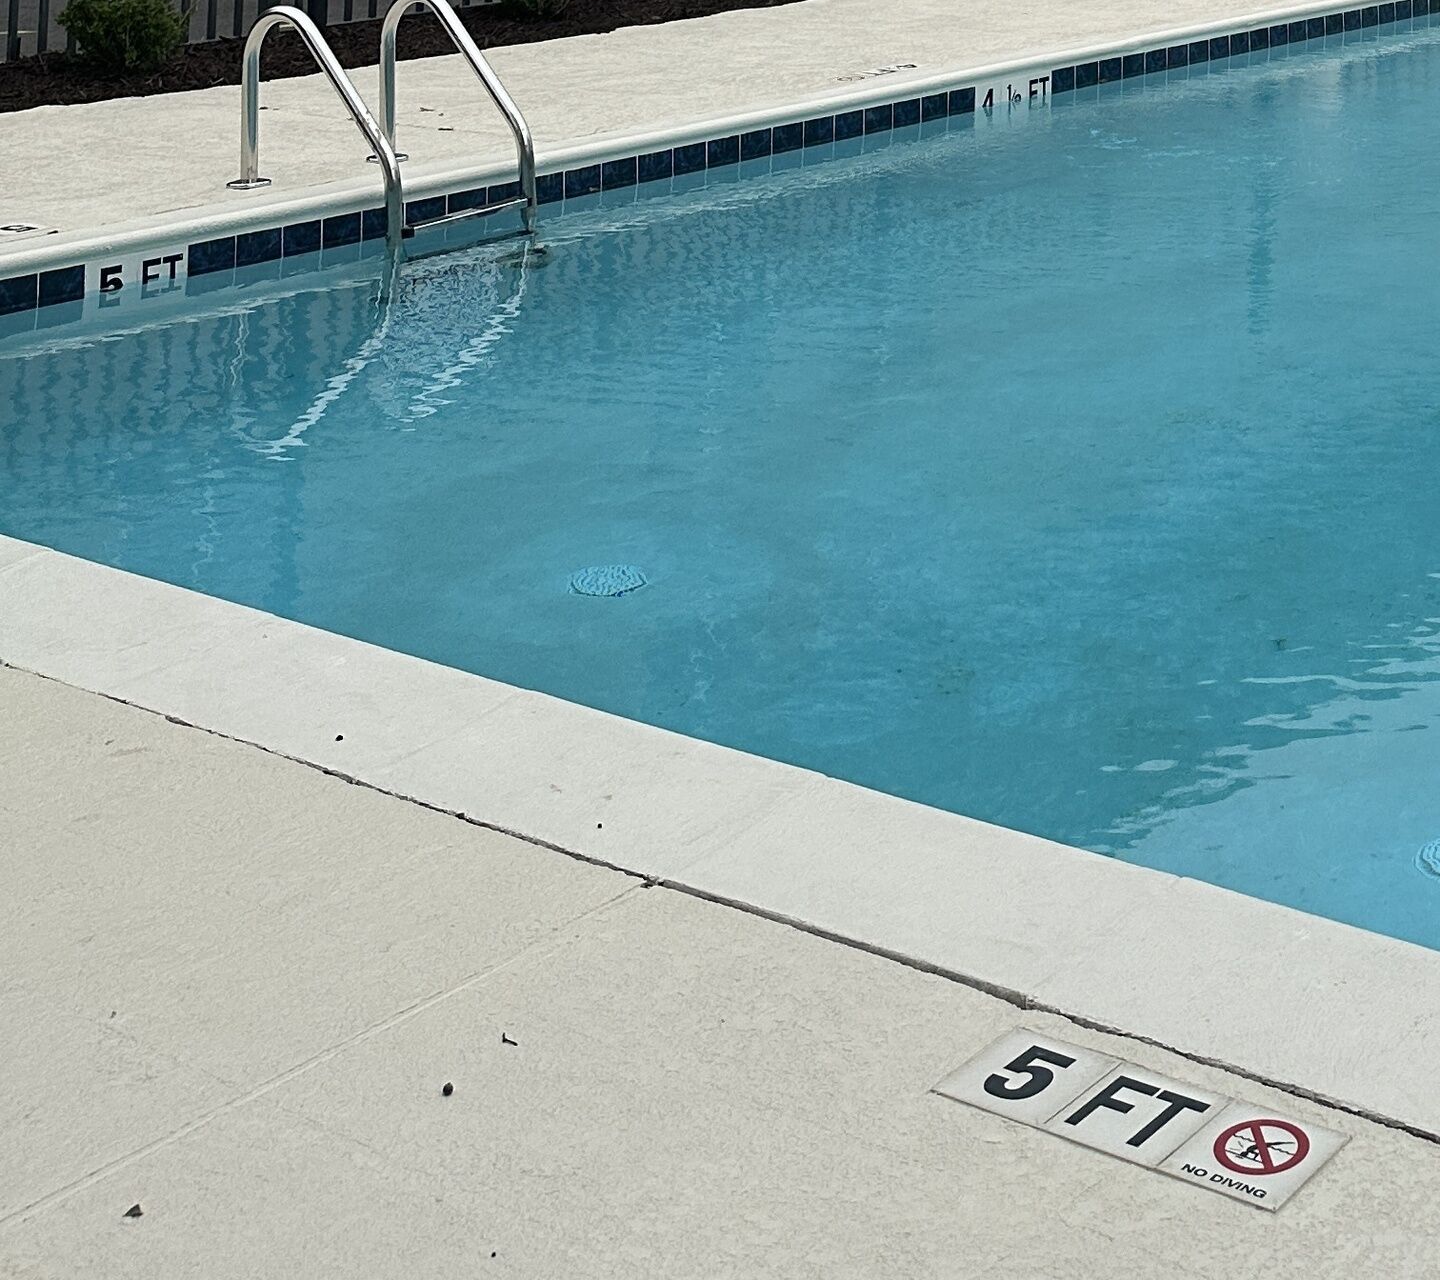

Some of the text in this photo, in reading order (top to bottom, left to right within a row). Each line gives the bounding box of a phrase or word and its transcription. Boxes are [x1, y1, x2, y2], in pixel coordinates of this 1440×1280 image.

[99, 253, 184, 296] 5 FT
[983, 1045, 1211, 1148] 5 FT
[1180, 1163, 1268, 1199] NO DIVING
